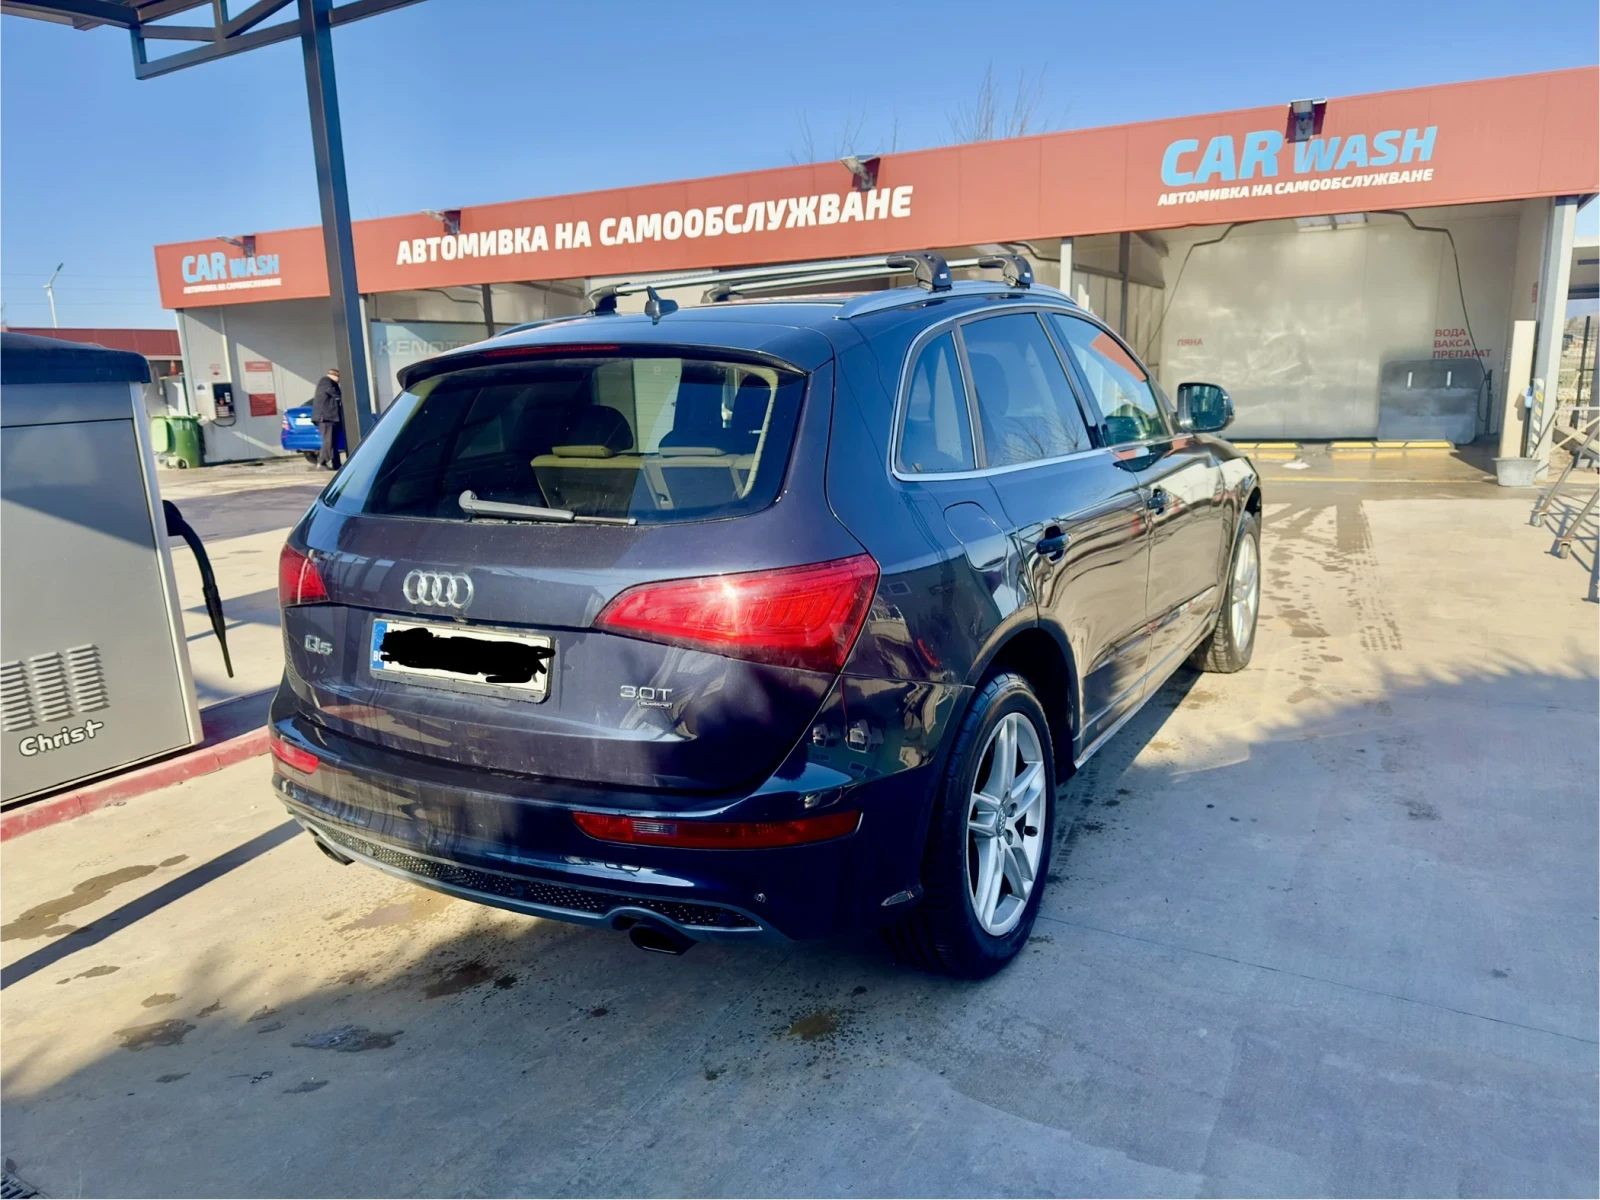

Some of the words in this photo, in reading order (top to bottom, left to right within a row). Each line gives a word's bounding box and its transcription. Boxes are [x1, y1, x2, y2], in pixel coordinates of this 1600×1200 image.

[1160, 130, 1283, 186] CAR
[1293, 126, 1438, 174] WASH
[1157, 186, 1250, 206] АВТОМИВКА
[1251, 184, 1273, 197] НА
[1274, 168, 1434, 195] САМООБСЛУЖВАНЕ
[396, 225, 549, 265] АВТОМИВКА
[555, 221, 592, 250] НА
[599, 185, 914, 246] САМООБСЛУЖВАНЕ
[182, 252, 227, 283] CAR
[229, 254, 279, 279] WASH
[1433, 339, 1471, 348] ВАКСА
[1435, 328, 1466, 338] ВОДА
[379, 340, 470, 356] KENOT
[1432, 349, 1492, 359] ПРЕПАРАТ
[304, 634, 334, 656] Q5
[19, 719, 104, 757] Christ
